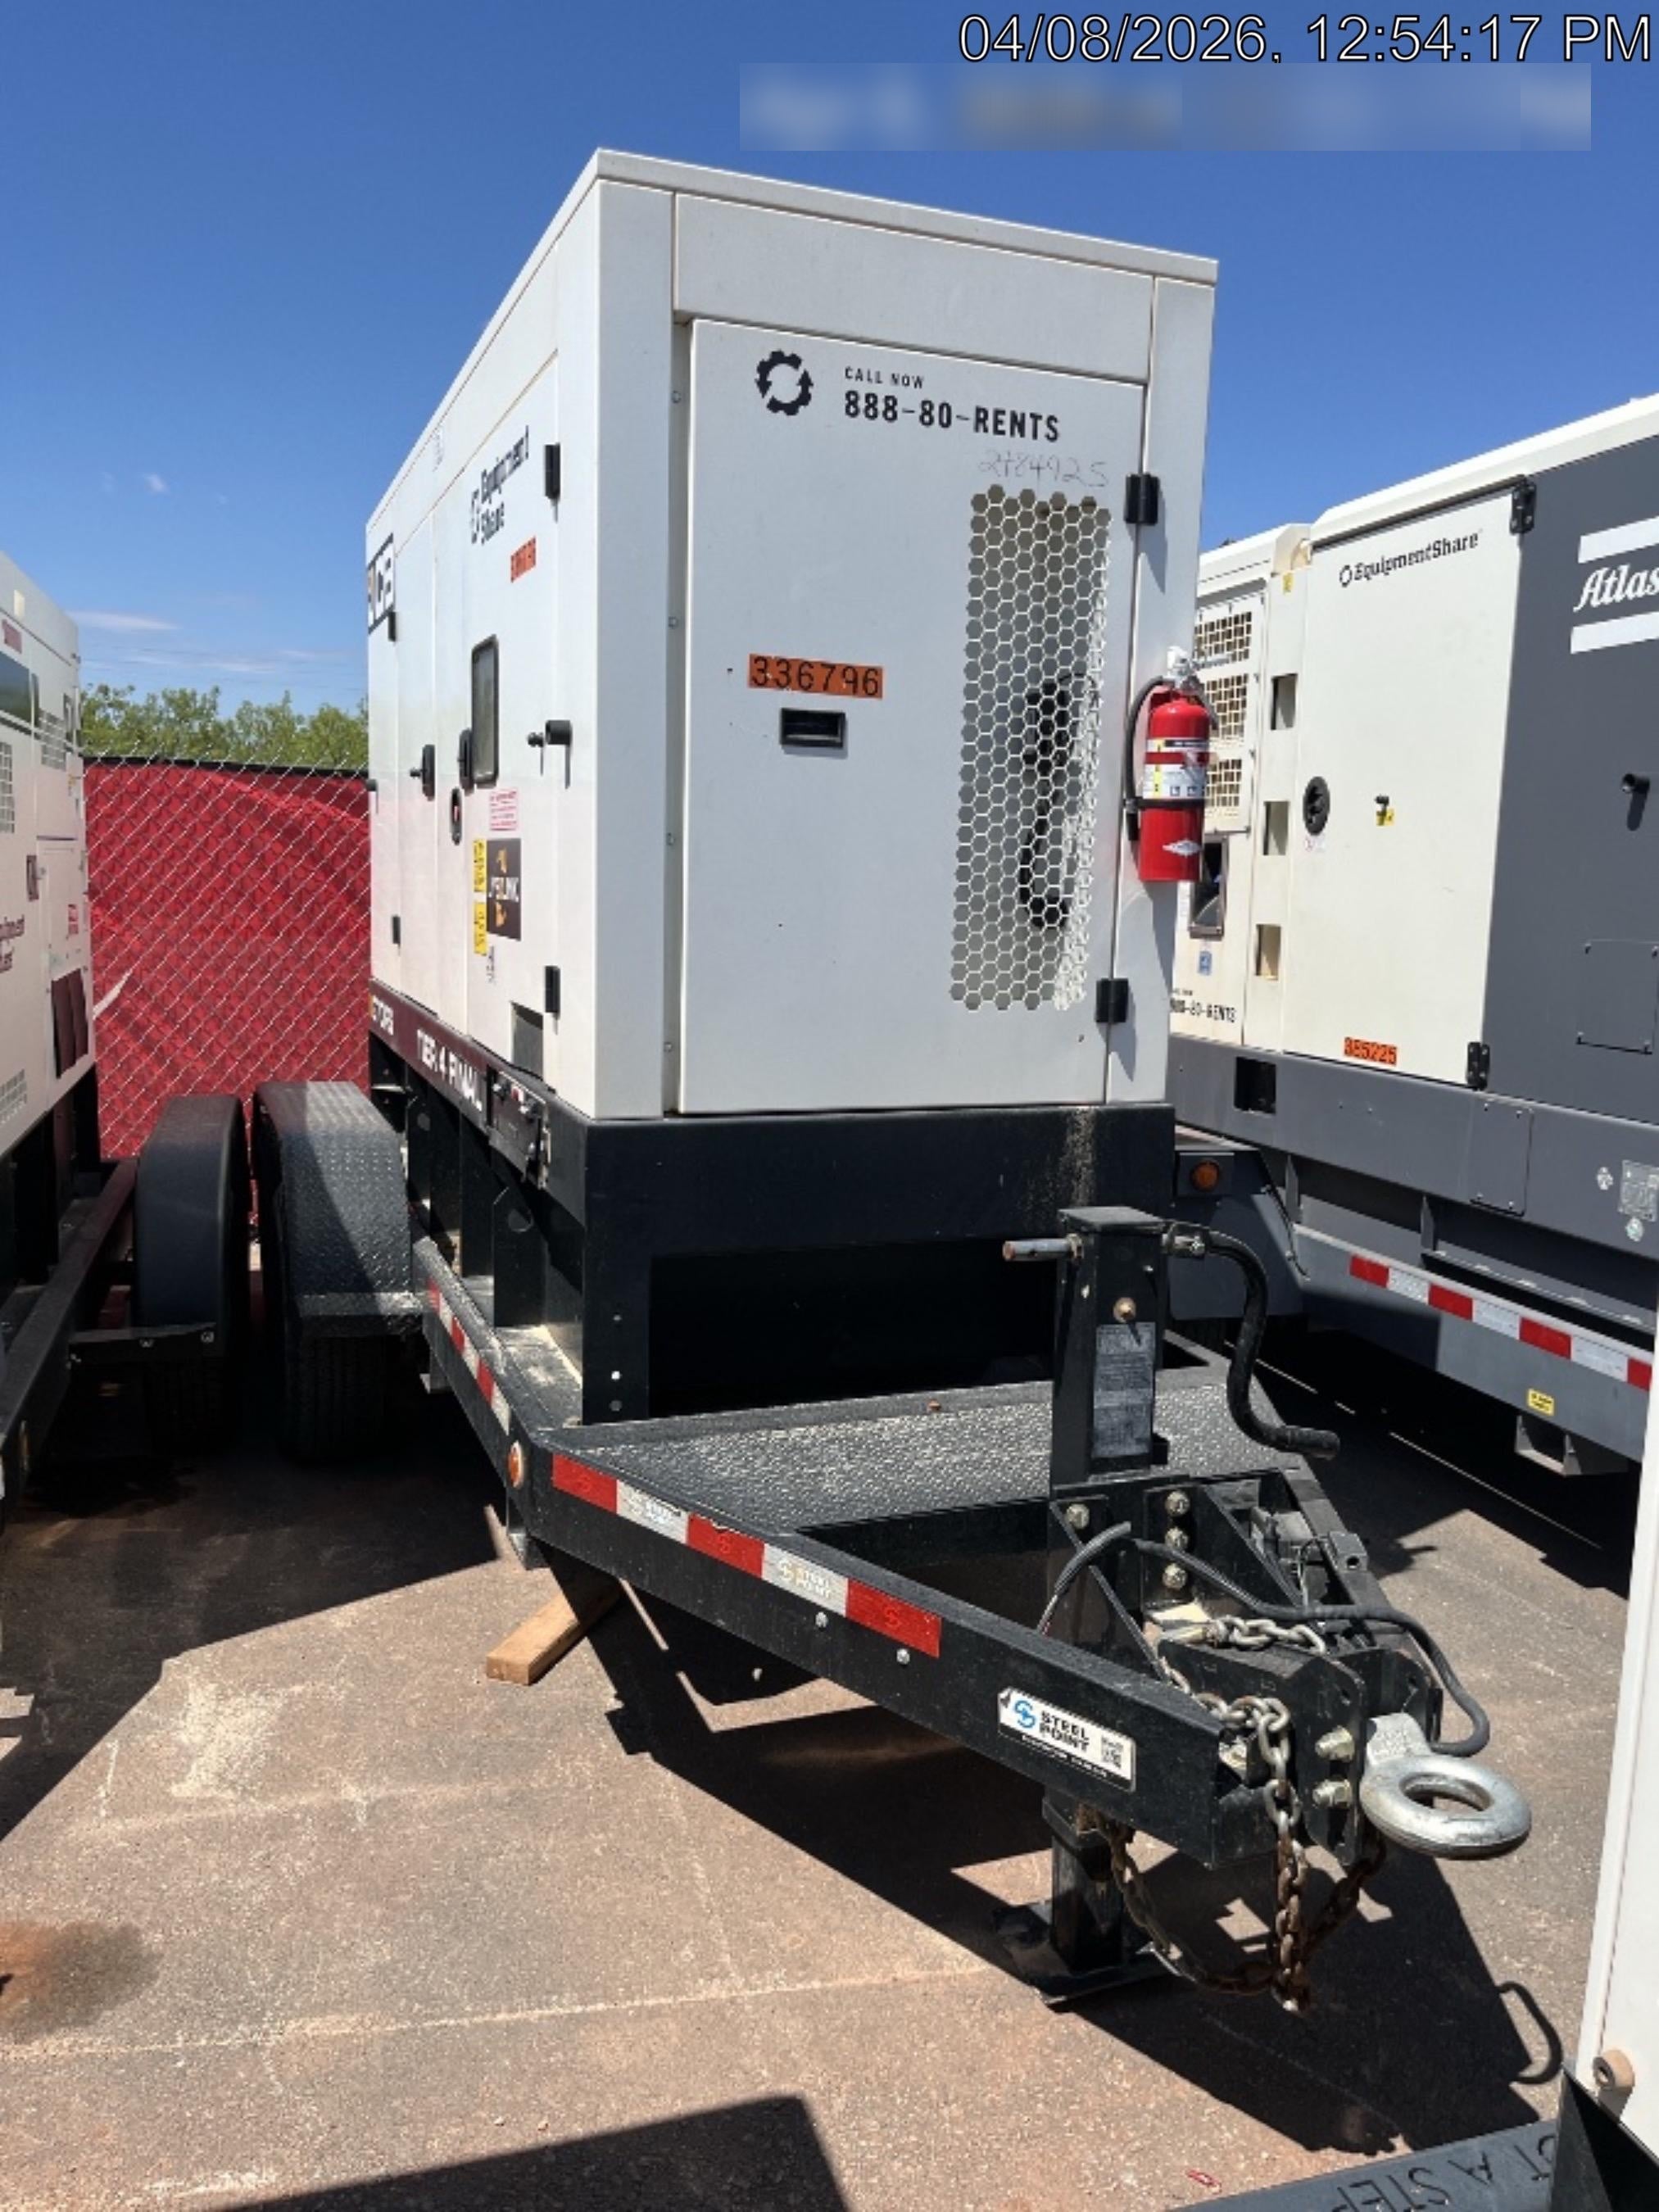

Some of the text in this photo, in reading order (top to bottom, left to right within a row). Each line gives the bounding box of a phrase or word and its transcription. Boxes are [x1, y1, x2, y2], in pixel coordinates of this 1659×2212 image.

[844, 365, 924, 390] CALL NOW
[844, 390, 1060, 442] 888-80-RENTS
[1353, 533, 1479, 582] EquipmentShare
[750, 655, 880, 696] 336796
[1040, 1710, 1090, 1741] STEEL
[1040, 1721, 1090, 1752] POINT
